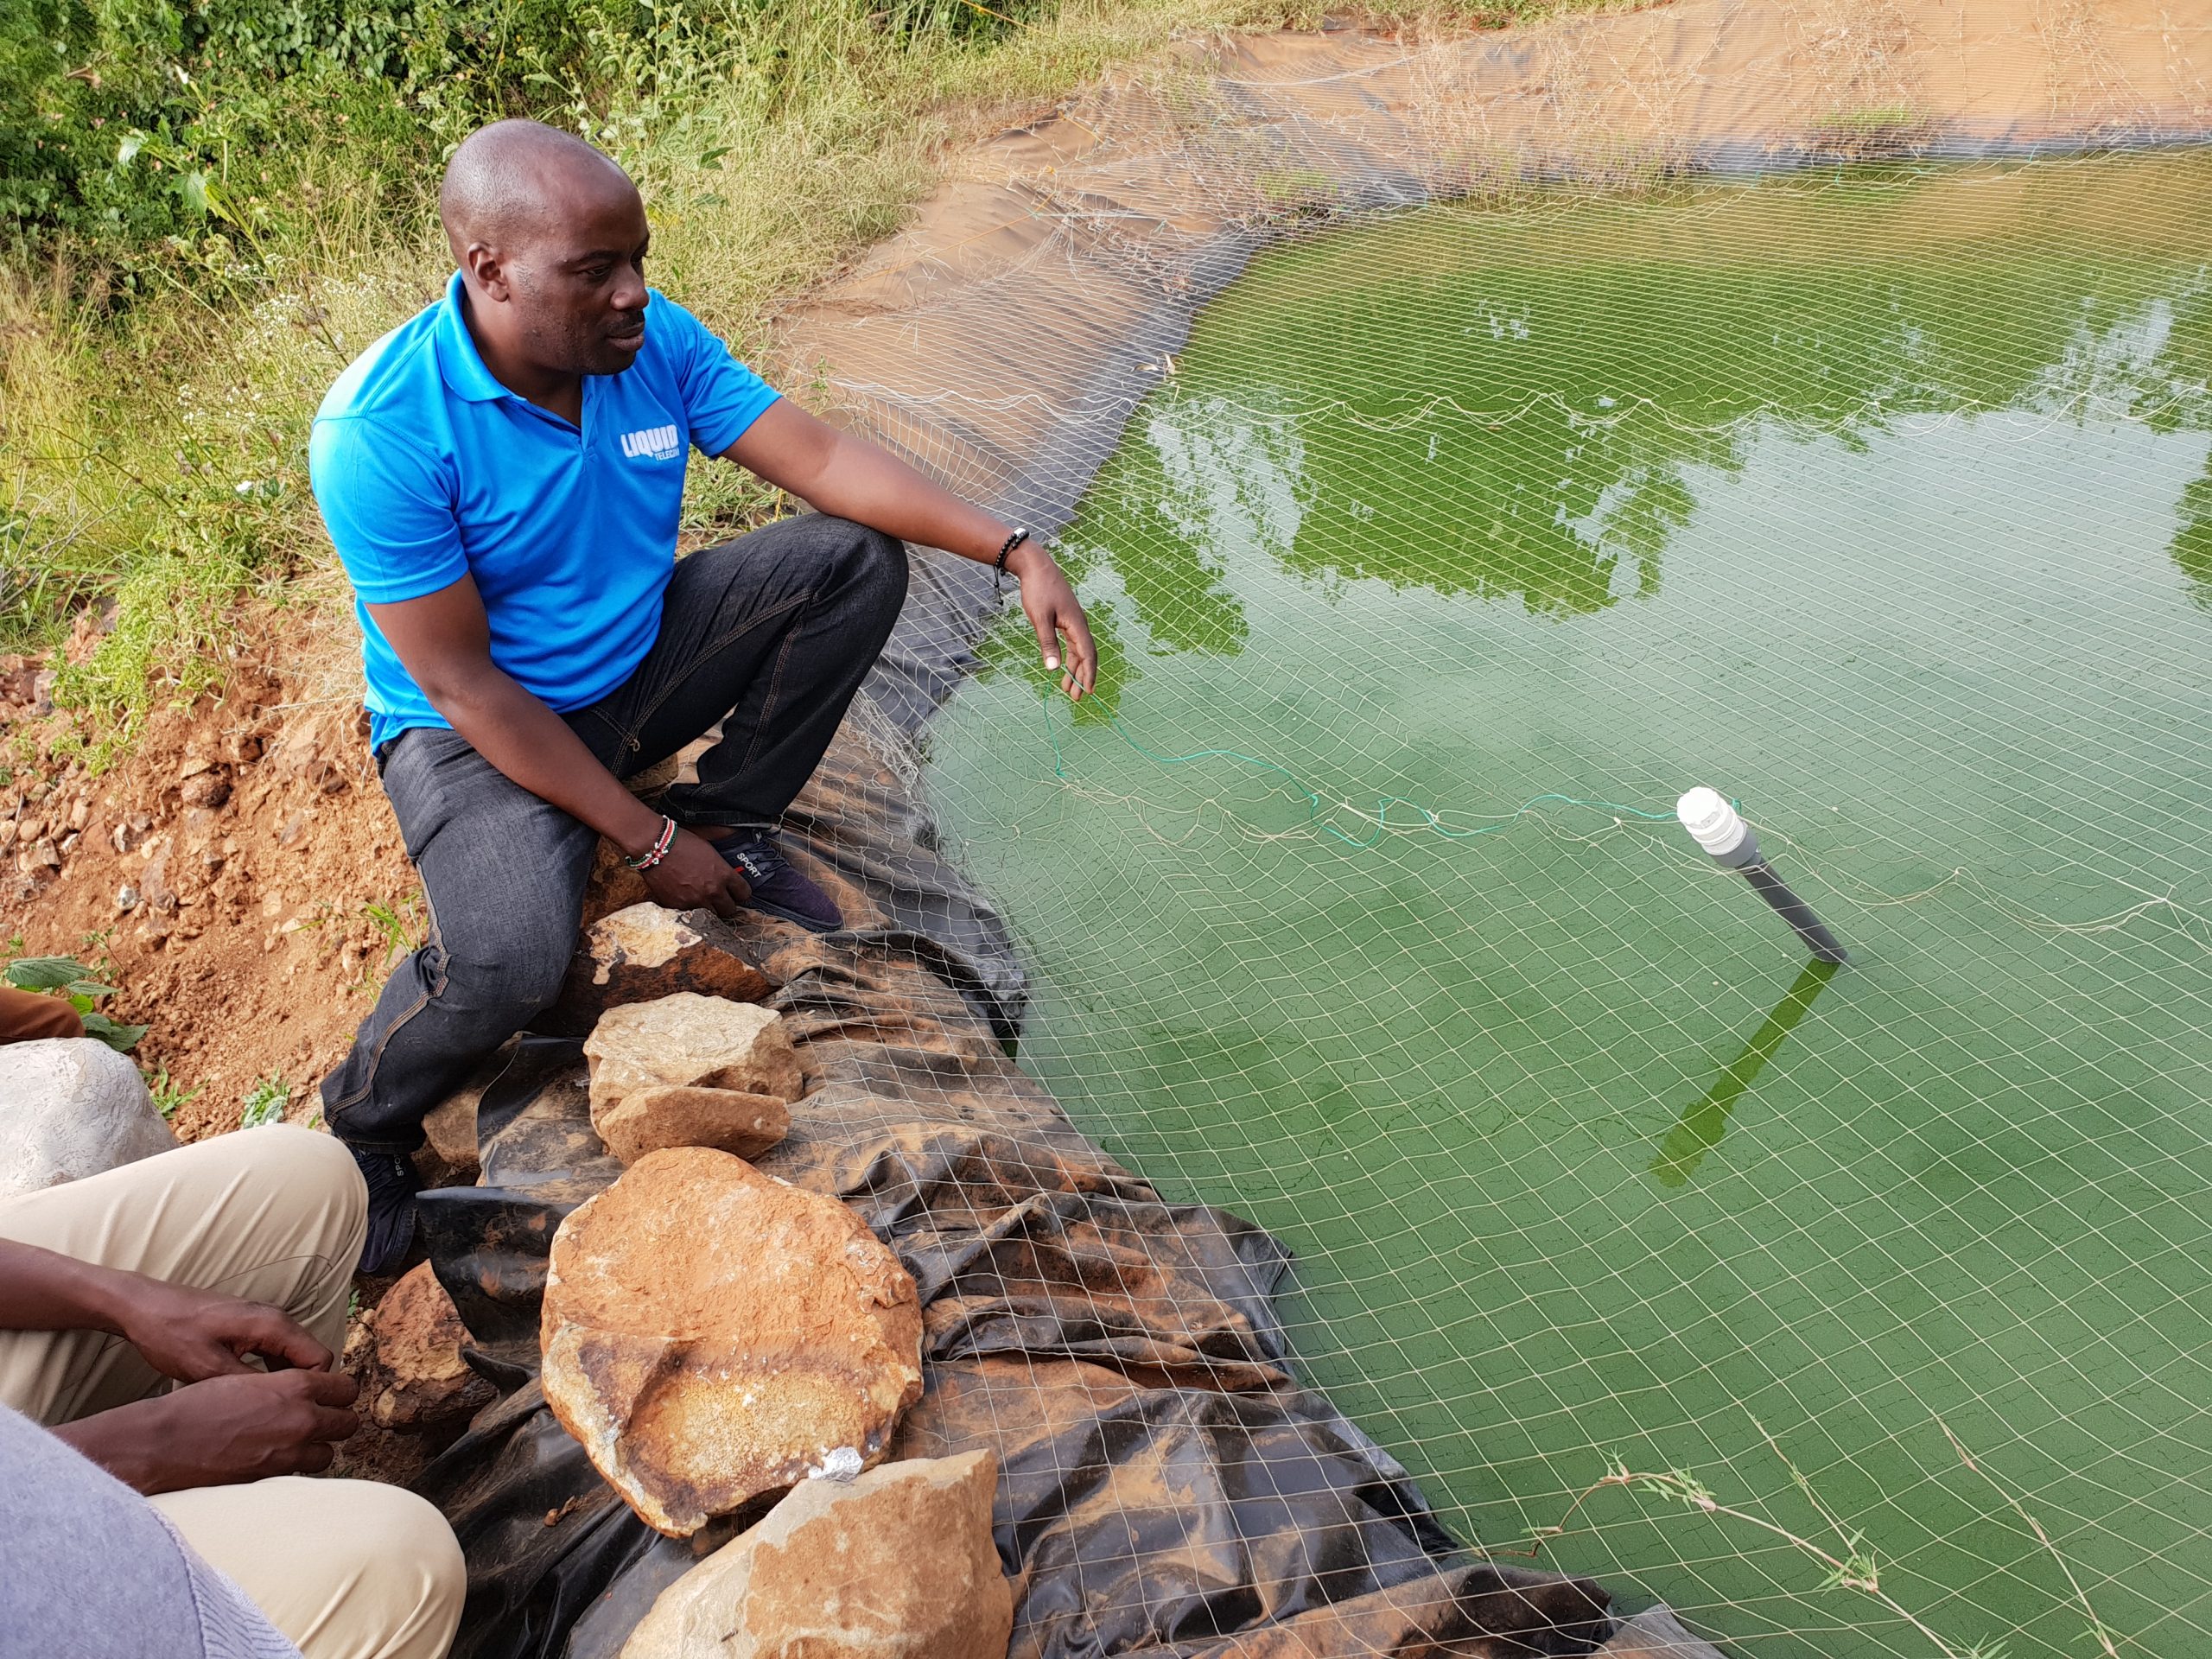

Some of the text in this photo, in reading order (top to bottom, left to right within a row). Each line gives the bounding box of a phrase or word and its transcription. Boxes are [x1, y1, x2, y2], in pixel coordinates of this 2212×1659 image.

[620, 424, 678, 458] LIQUID
[736, 852, 761, 878] SPORT
[393, 1154, 404, 1177] SPO
